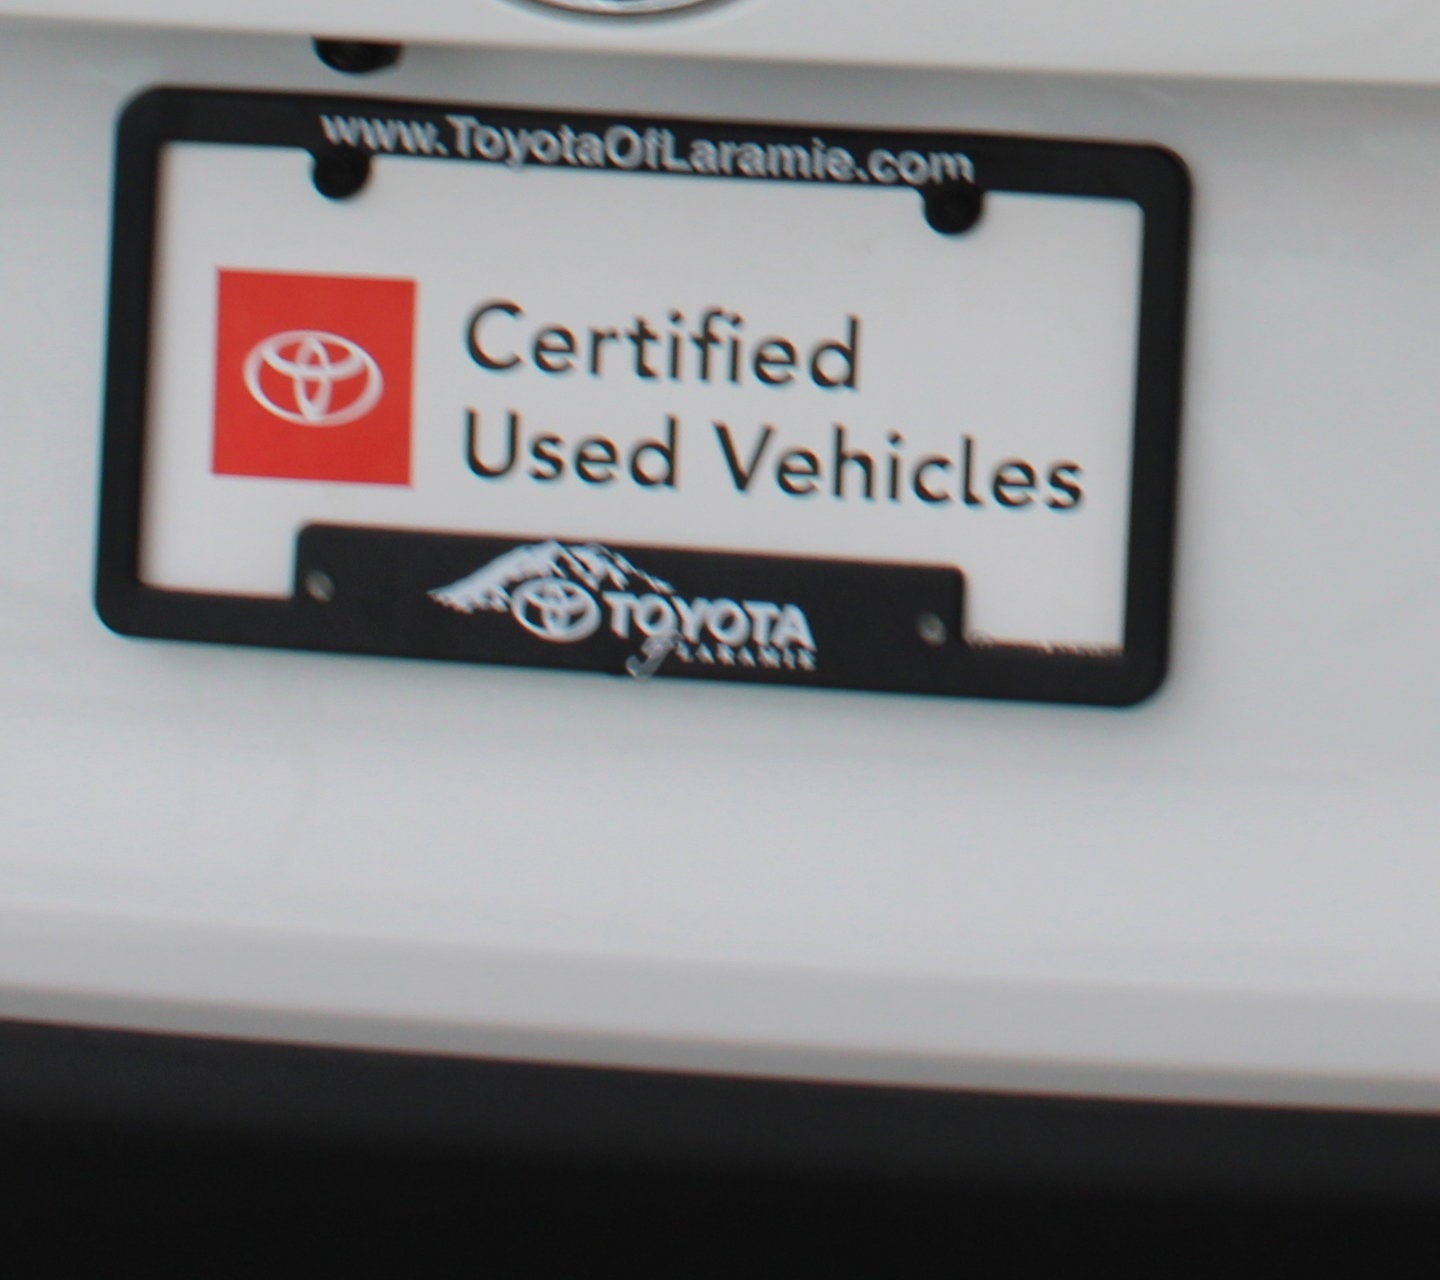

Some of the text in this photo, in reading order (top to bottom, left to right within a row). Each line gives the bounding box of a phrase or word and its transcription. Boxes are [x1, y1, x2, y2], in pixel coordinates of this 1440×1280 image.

[319, 112, 975, 186] www.ToyotaOfLaramie.com
[464, 298, 861, 390] Certified
[463, 408, 1085, 512] Used Vehicles
[601, 589, 818, 653] TOYOTA
